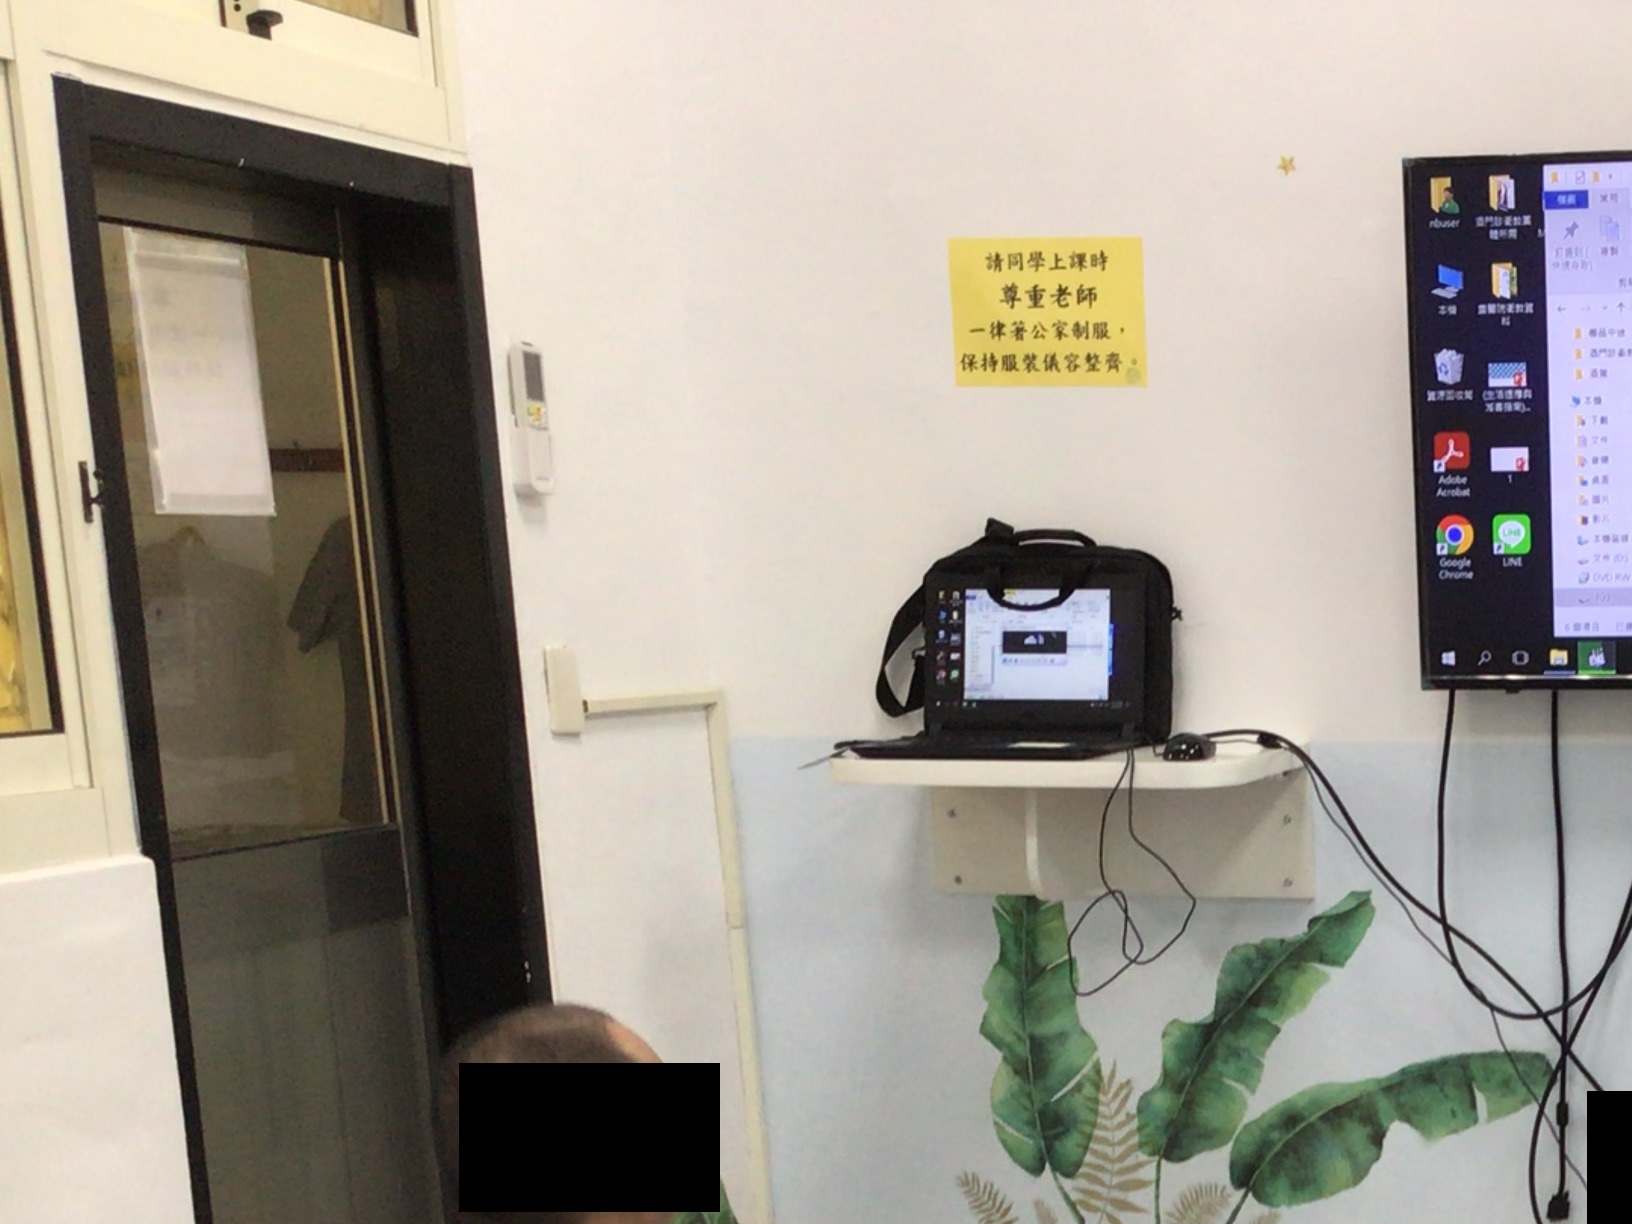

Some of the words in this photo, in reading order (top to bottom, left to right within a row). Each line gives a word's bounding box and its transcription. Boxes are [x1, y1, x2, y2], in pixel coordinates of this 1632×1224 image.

[1429, 217, 1460, 228] nbuser
[985, 250, 1109, 272] 請同學上課時
[999, 283, 1097, 309] 尊重老師
[960, 351, 1138, 374] 保持服裝儀容整齊。
[1438, 475, 1468, 485] Adobe
[1436, 487, 1471, 497] Acrobat
[1440, 557, 1471, 570] Google
[1502, 557, 1523, 567] LINE
[1438, 569, 1474, 580] Chrome
